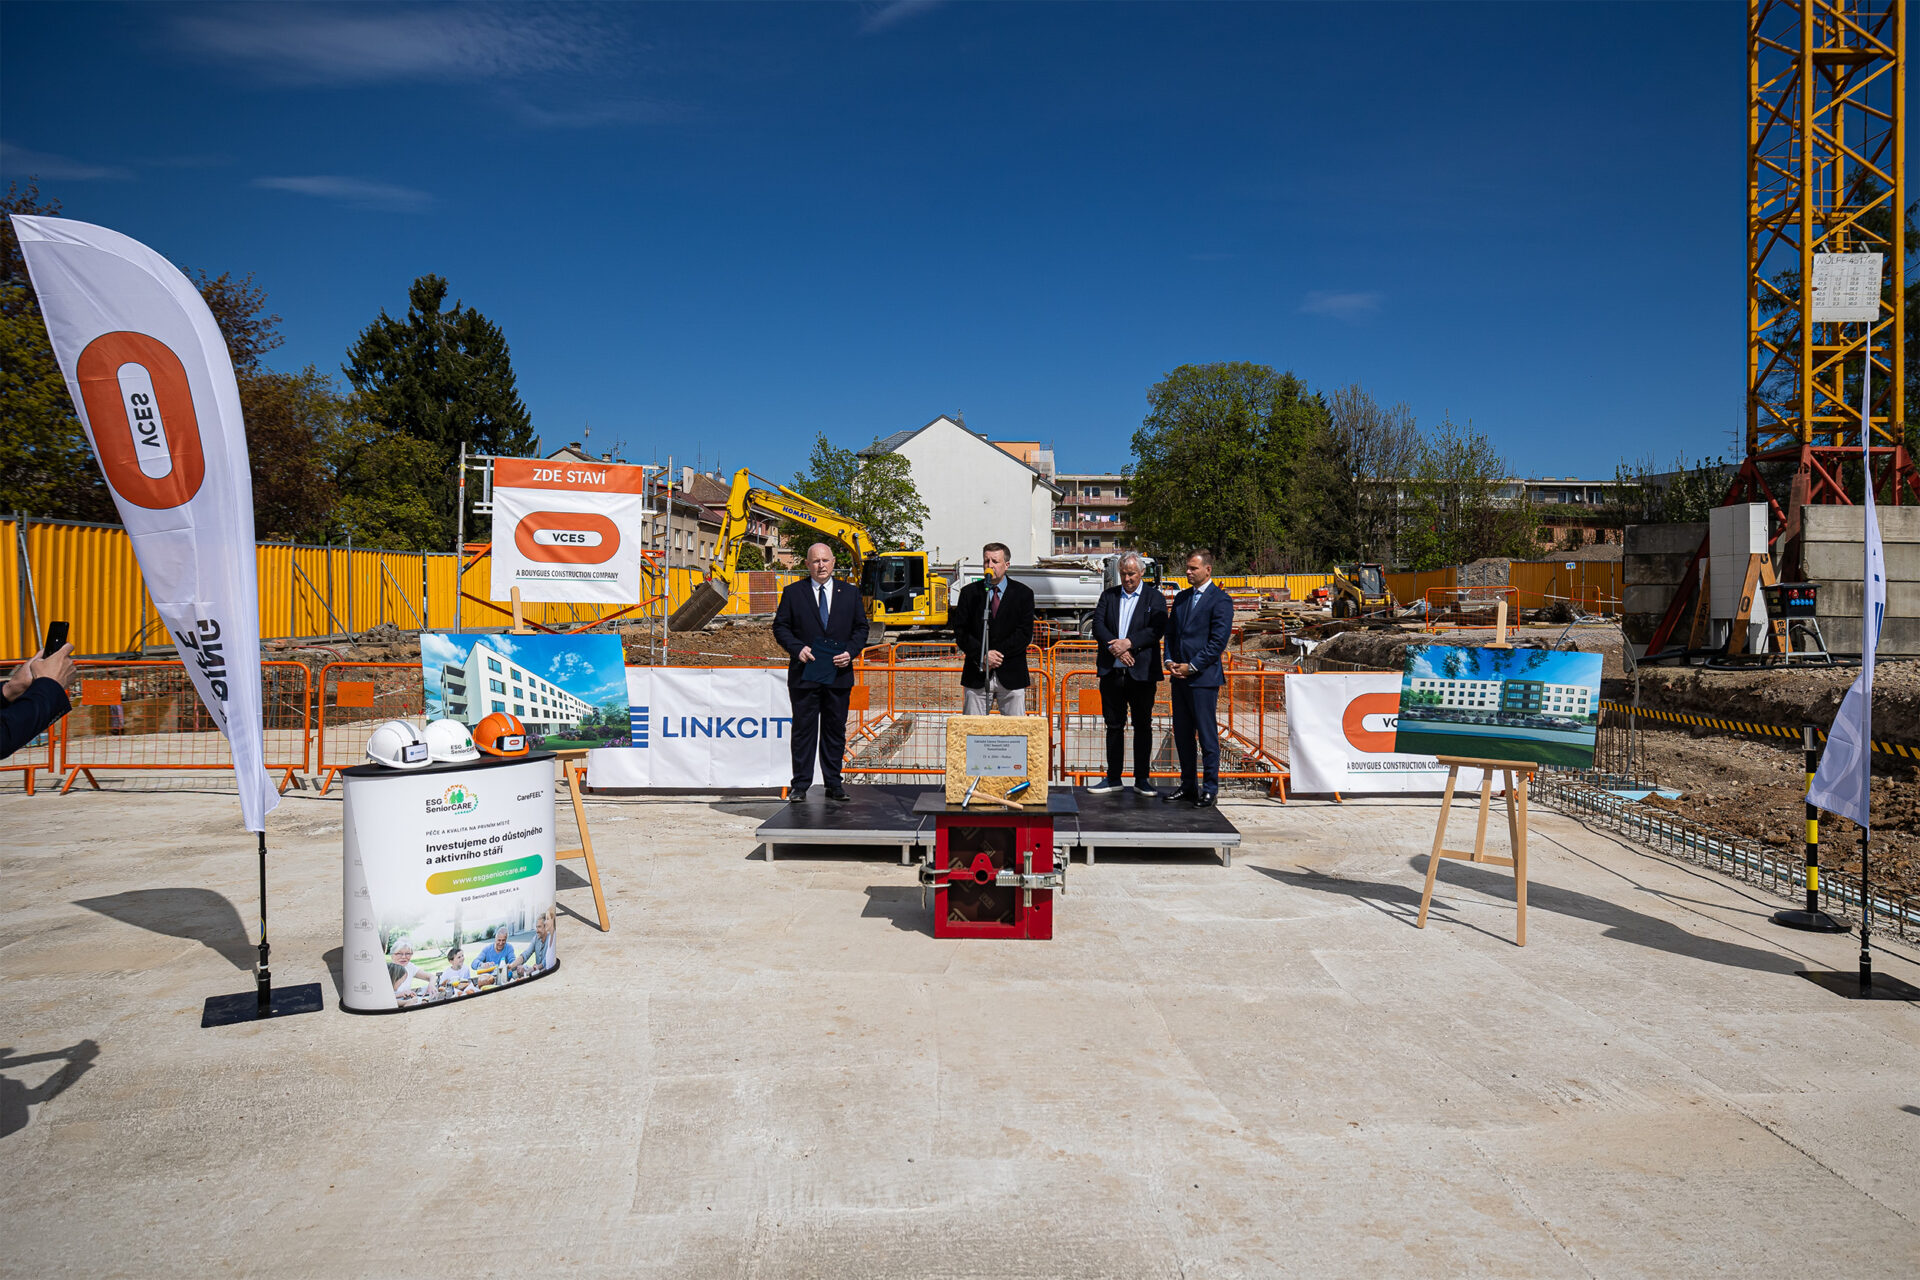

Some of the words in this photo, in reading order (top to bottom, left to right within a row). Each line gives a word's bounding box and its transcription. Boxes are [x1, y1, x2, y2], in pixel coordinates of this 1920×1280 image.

[532, 468, 562, 482] ZDE
[566, 470, 607, 485] STAVÍ
[782, 505, 817, 523] KOMATSU
[552, 533, 586, 543] VCES
[521, 570, 550, 578] BOUYGUES
[552, 570, 592, 579] CONSTRUCTION
[662, 716, 792, 738] LINKCIT
[1383, 718, 1398, 728] VC
[1347, 762, 1351, 770] A
[1352, 762, 1382, 770] BOUYGUES
[1383, 761, 1427, 770] CONSTRUCTION
[425, 798, 442, 806] ESG
[425, 802, 472, 813] SeniorCARE
[426, 839, 487, 853] Investujeme
[489, 836, 500, 844] do
[502, 827, 543, 842] důstojného
[435, 850, 481, 864] aktivního
[483, 845, 504, 857] stáří
[452, 866, 527, 885] www.esgseniorcare.eu
